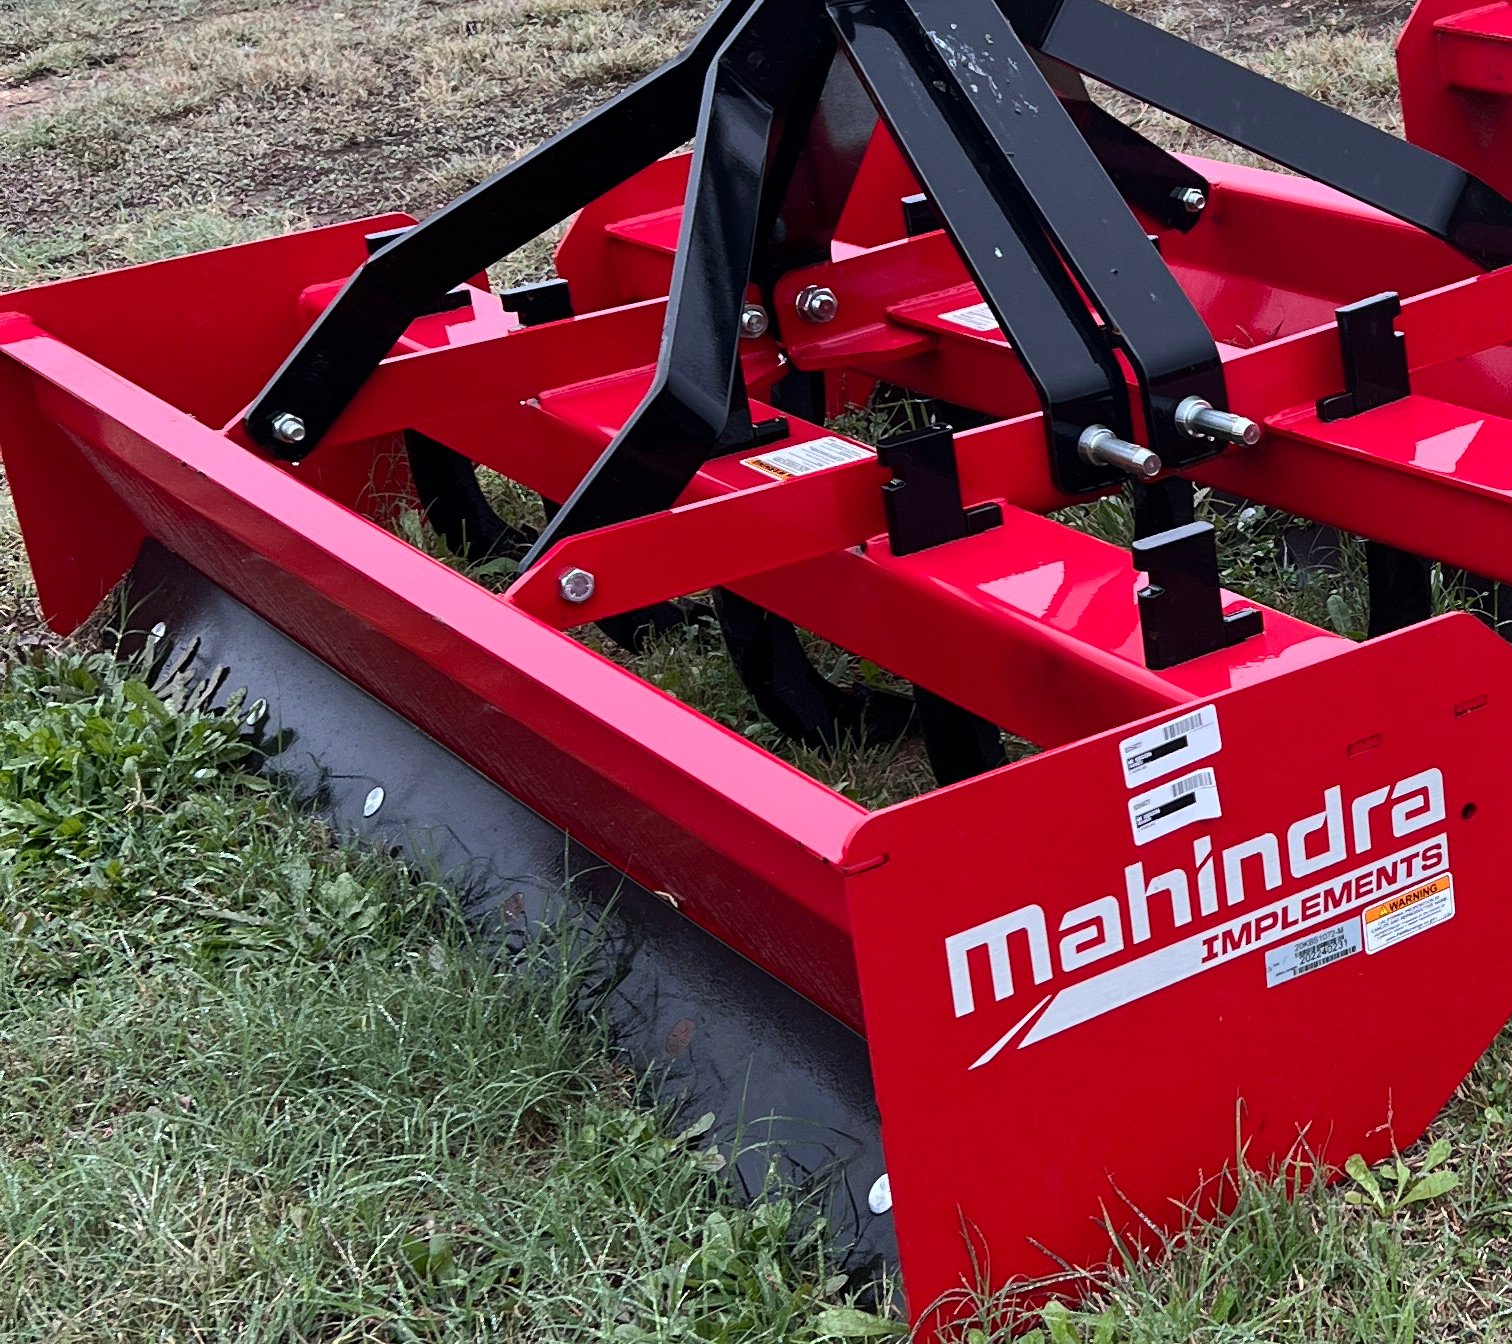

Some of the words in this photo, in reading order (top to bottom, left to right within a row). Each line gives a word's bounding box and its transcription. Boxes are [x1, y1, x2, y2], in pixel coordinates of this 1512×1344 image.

[945, 768, 1446, 1018] Mahindra
[1201, 842, 1444, 964] IMPLEMENTS
[1389, 884, 1438, 911] WARNING
